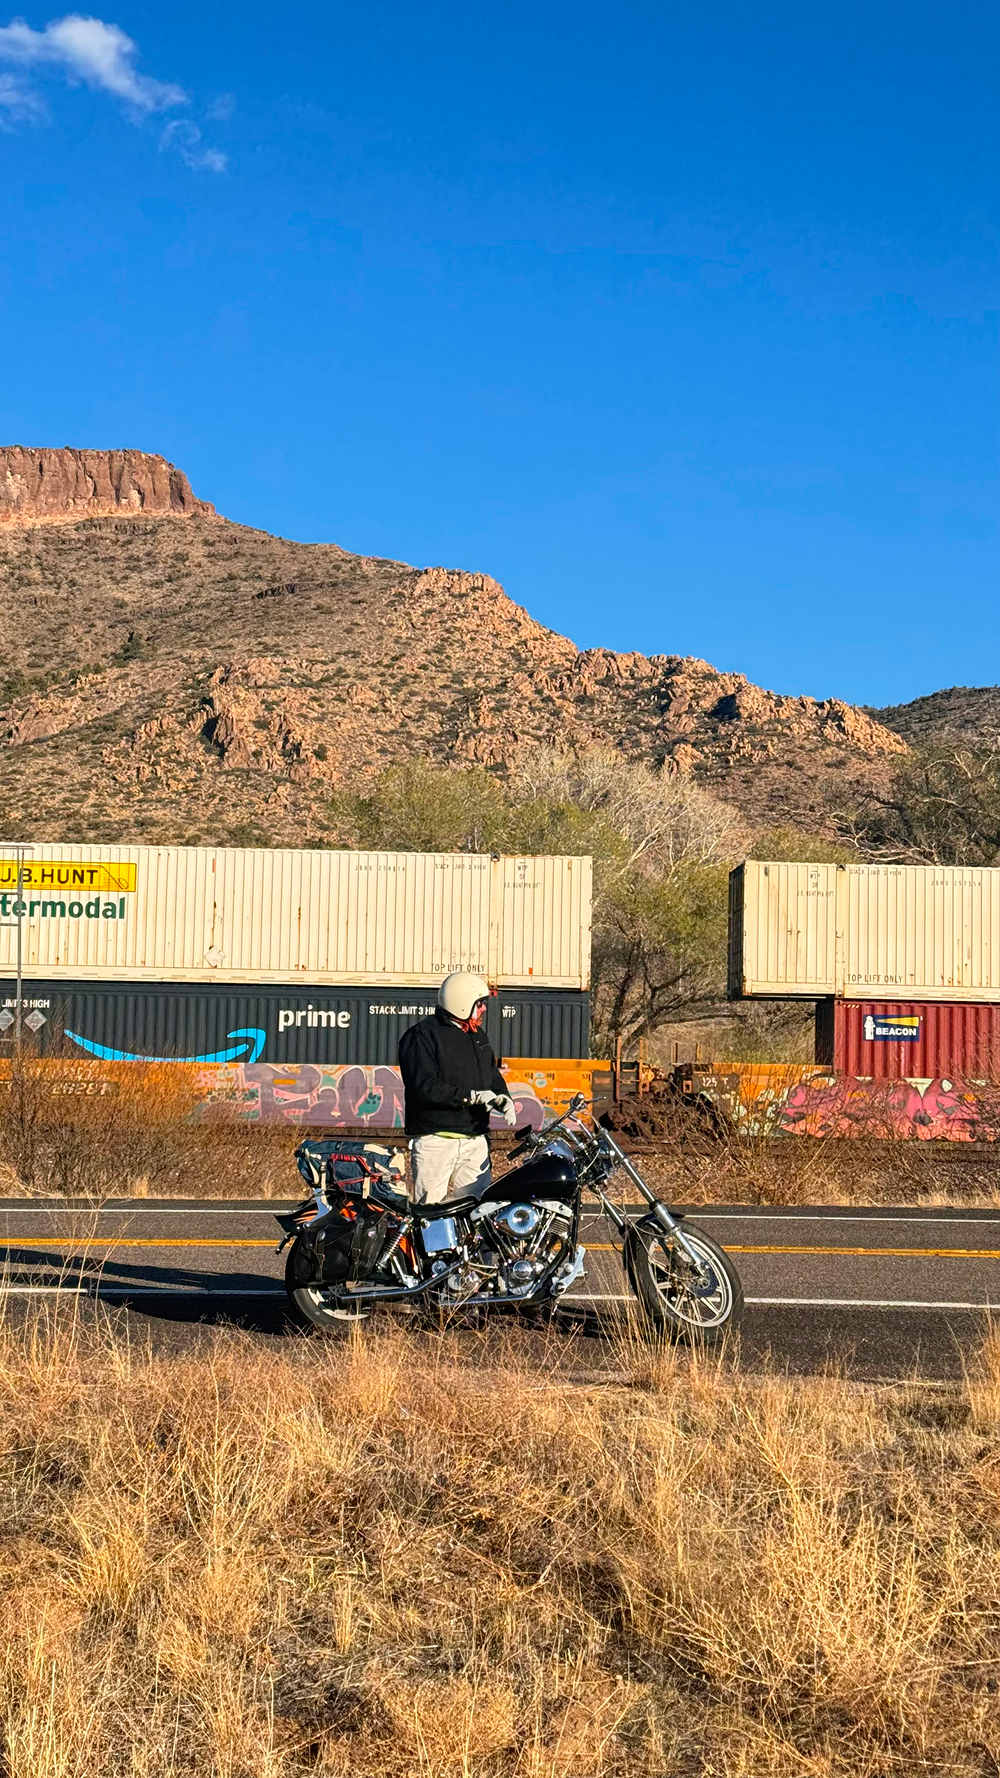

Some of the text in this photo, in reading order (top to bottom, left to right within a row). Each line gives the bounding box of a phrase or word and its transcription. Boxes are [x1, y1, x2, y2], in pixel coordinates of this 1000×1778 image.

[431, 963, 486, 973] TOP LIFT ONLY
[847, 973, 903, 983] TOP LIFT ONLY
[22, 999, 29, 1008] 3
[29, 999, 50, 1009] HIGH
[369, 1005, 396, 1015] STACK
[398, 1005, 418, 1015] LIMIT
[418, 1006, 424, 1015] 3
[502, 1009, 516, 1018] WTP
[278, 1004, 351, 1032] prime
[875, 1027, 917, 1036] BEACON
